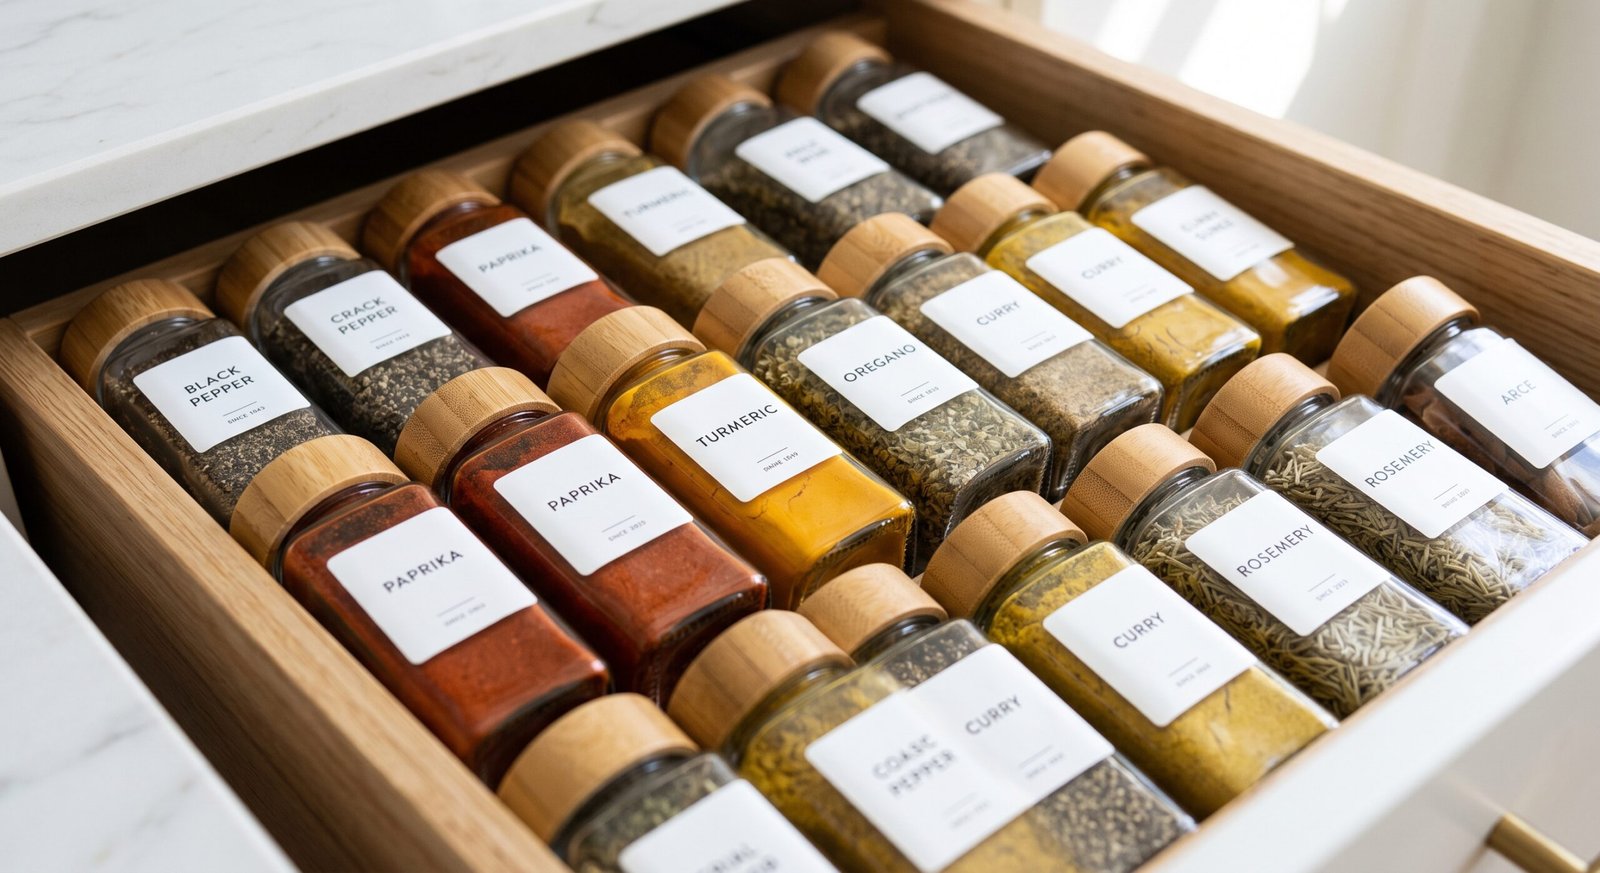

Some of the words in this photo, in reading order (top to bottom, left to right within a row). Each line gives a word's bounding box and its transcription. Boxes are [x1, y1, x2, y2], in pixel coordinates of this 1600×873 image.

[478, 244, 542, 273] PAPRIKA
[1081, 256, 1123, 279] CURRY
[330, 296, 387, 323] CRACK
[338, 305, 399, 335] PEPPER
[976, 300, 1020, 326] CURRY
[844, 344, 916, 382] OREGANO
[184, 366, 241, 394] BLACK
[190, 375, 255, 407] PEPPER
[1501, 379, 1536, 405] ARCE
[907, 393, 924, 404] SINCE
[227, 413, 248, 425] SINCE
[696, 404, 778, 447] TURMERIC
[1364, 440, 1435, 488] ROSEMERY
[547, 473, 621, 512] PAPRIKA
[1236, 524, 1314, 577] ROSEMERY
[382, 551, 463, 593] PAPRIKA
[1113, 612, 1164, 649] CURRY
[965, 695, 1021, 735] CURRY
[889, 749, 955, 796] PEPPER
